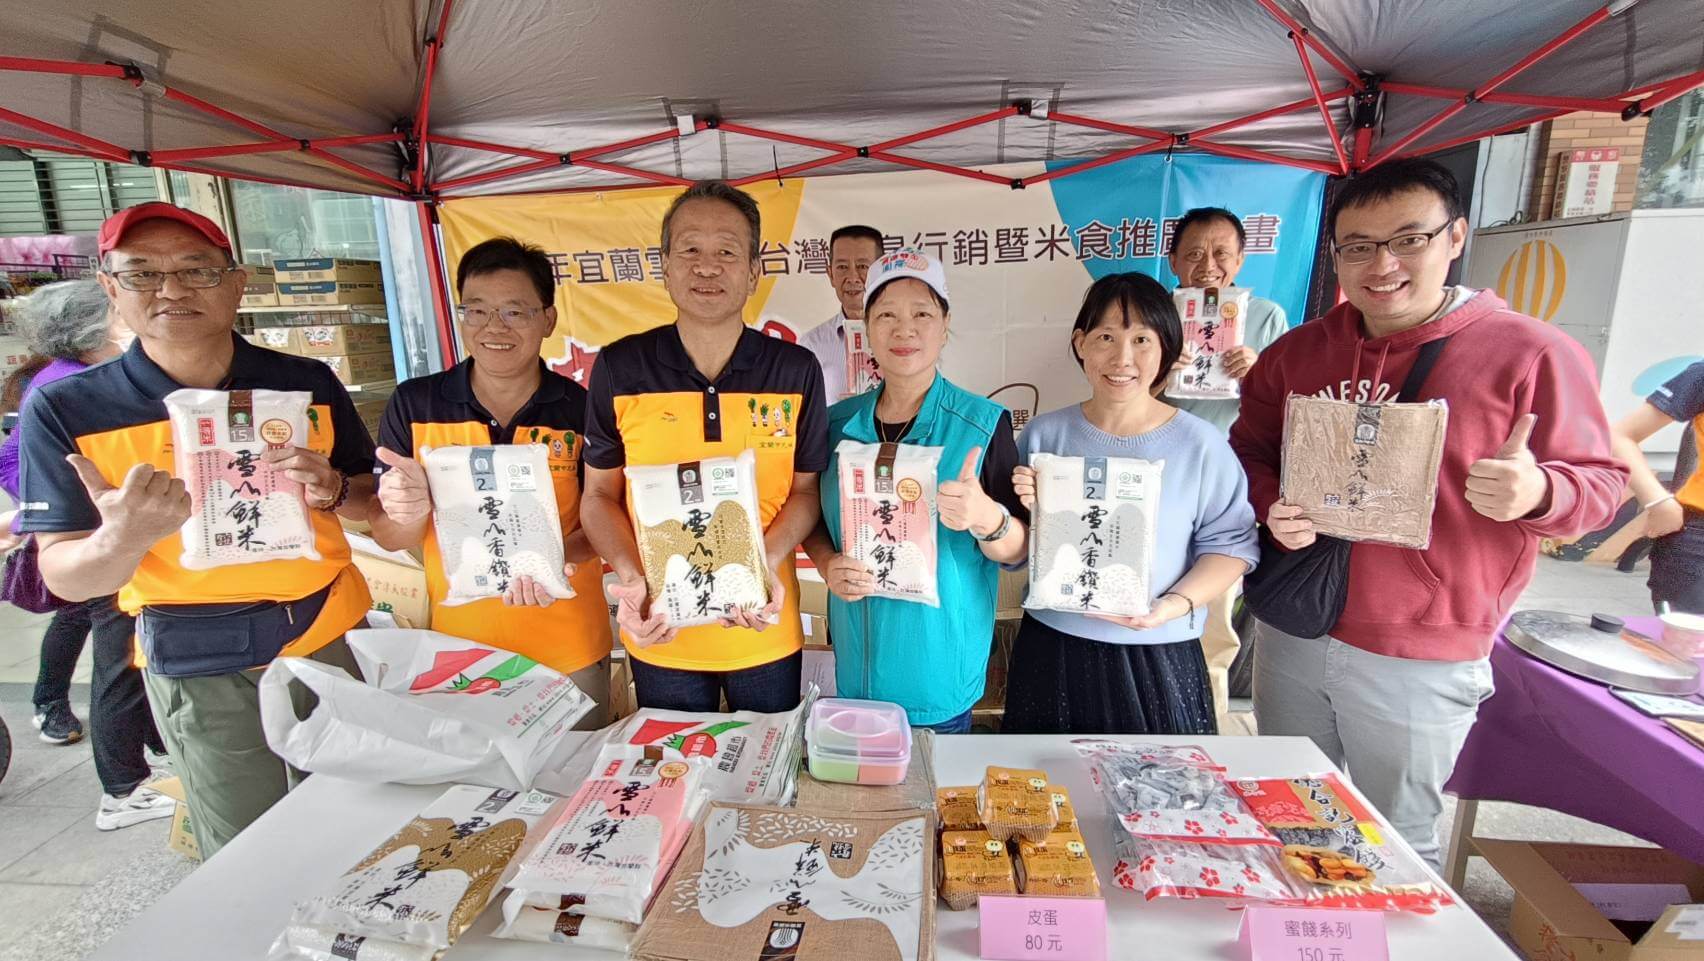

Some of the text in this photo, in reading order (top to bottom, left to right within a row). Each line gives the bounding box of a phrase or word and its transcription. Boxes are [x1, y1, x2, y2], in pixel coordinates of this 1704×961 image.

[476, 478, 487, 491] 2
[1086, 486, 1096, 499] 2
[226, 449, 266, 551] 雪山鮮米
[684, 490, 695, 504] 2
[870, 500, 899, 588] 雪山鮮米
[682, 508, 722, 616] 雪山鮮米
[576, 781, 650, 862] 雪山鮮米
[1027, 909, 1059, 927] 皮蛋
[1284, 920, 1353, 939] 蜜餞系列
[1025, 935, 1063, 951] 80 元
[1298, 947, 1345, 961] 150 元
